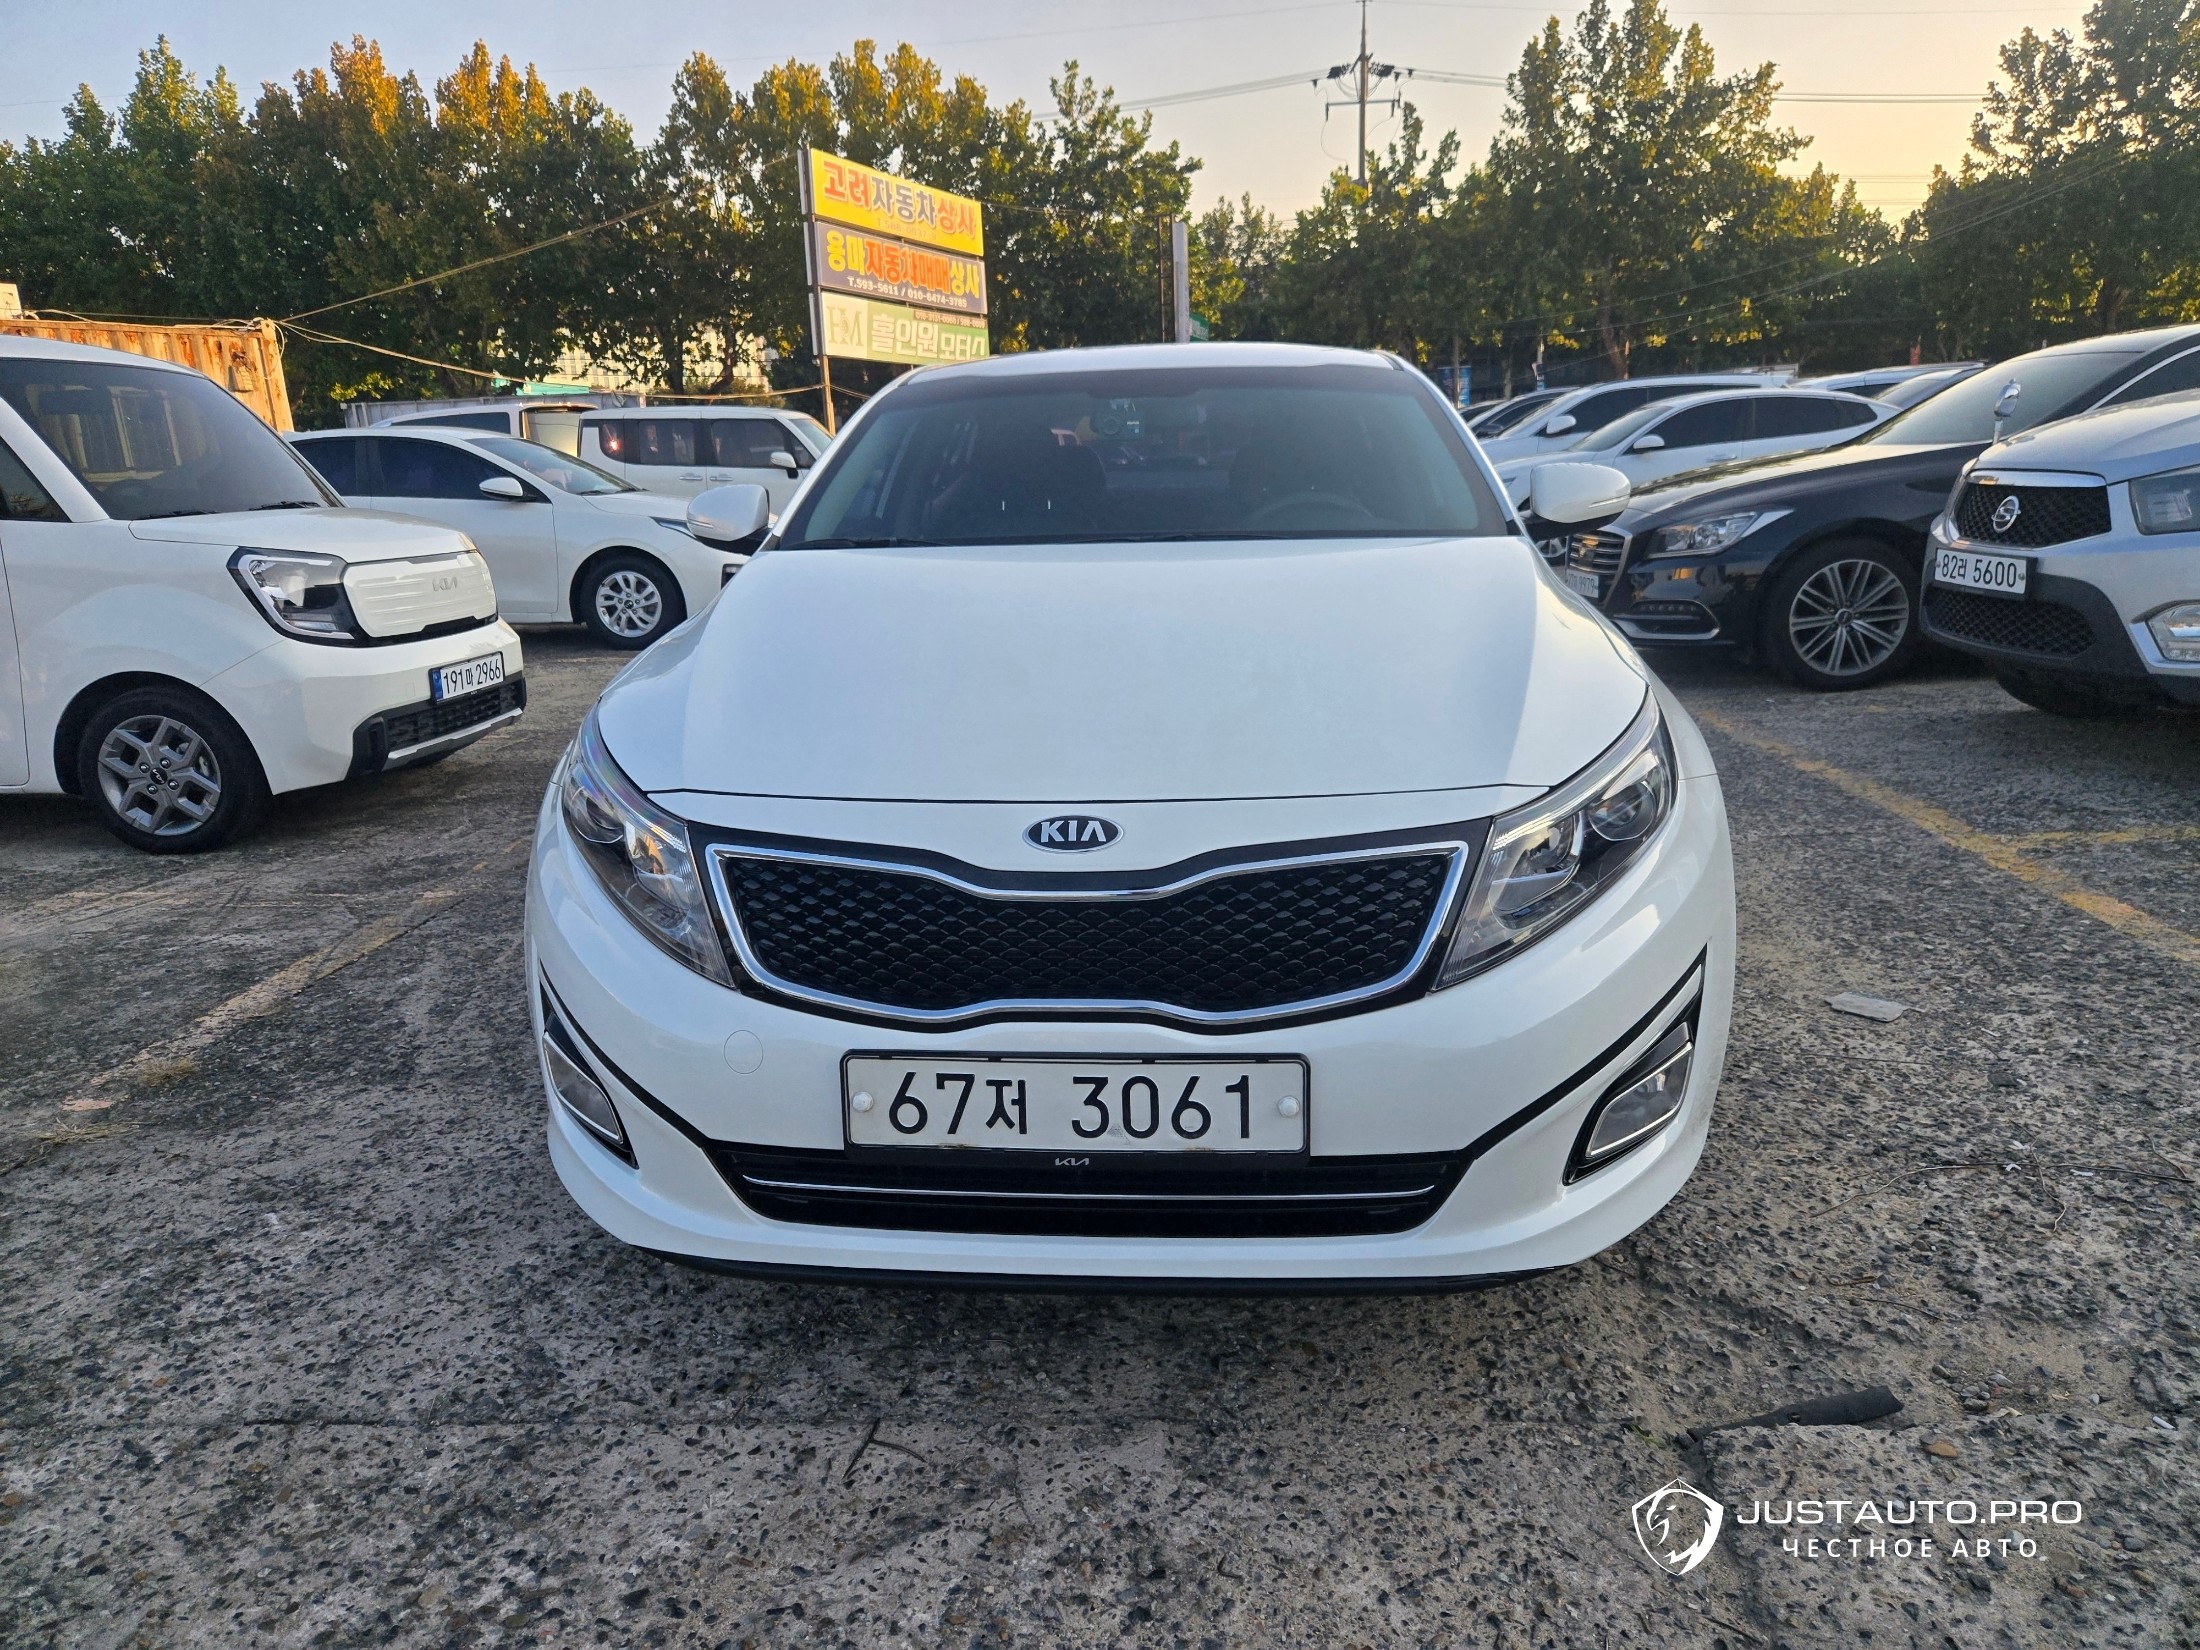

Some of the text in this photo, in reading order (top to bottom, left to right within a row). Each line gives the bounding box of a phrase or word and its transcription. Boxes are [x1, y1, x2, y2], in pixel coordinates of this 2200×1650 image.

[823, 160, 976, 239] 고려자동차상사
[826, 230, 980, 298] 용마자동차매매상사
[1942, 553, 2017, 588] 82러 5600
[1040, 819, 1107, 843] KIA
[888, 1071, 1250, 1140] 67저 3061
[1054, 1157, 1090, 1166] KIA
